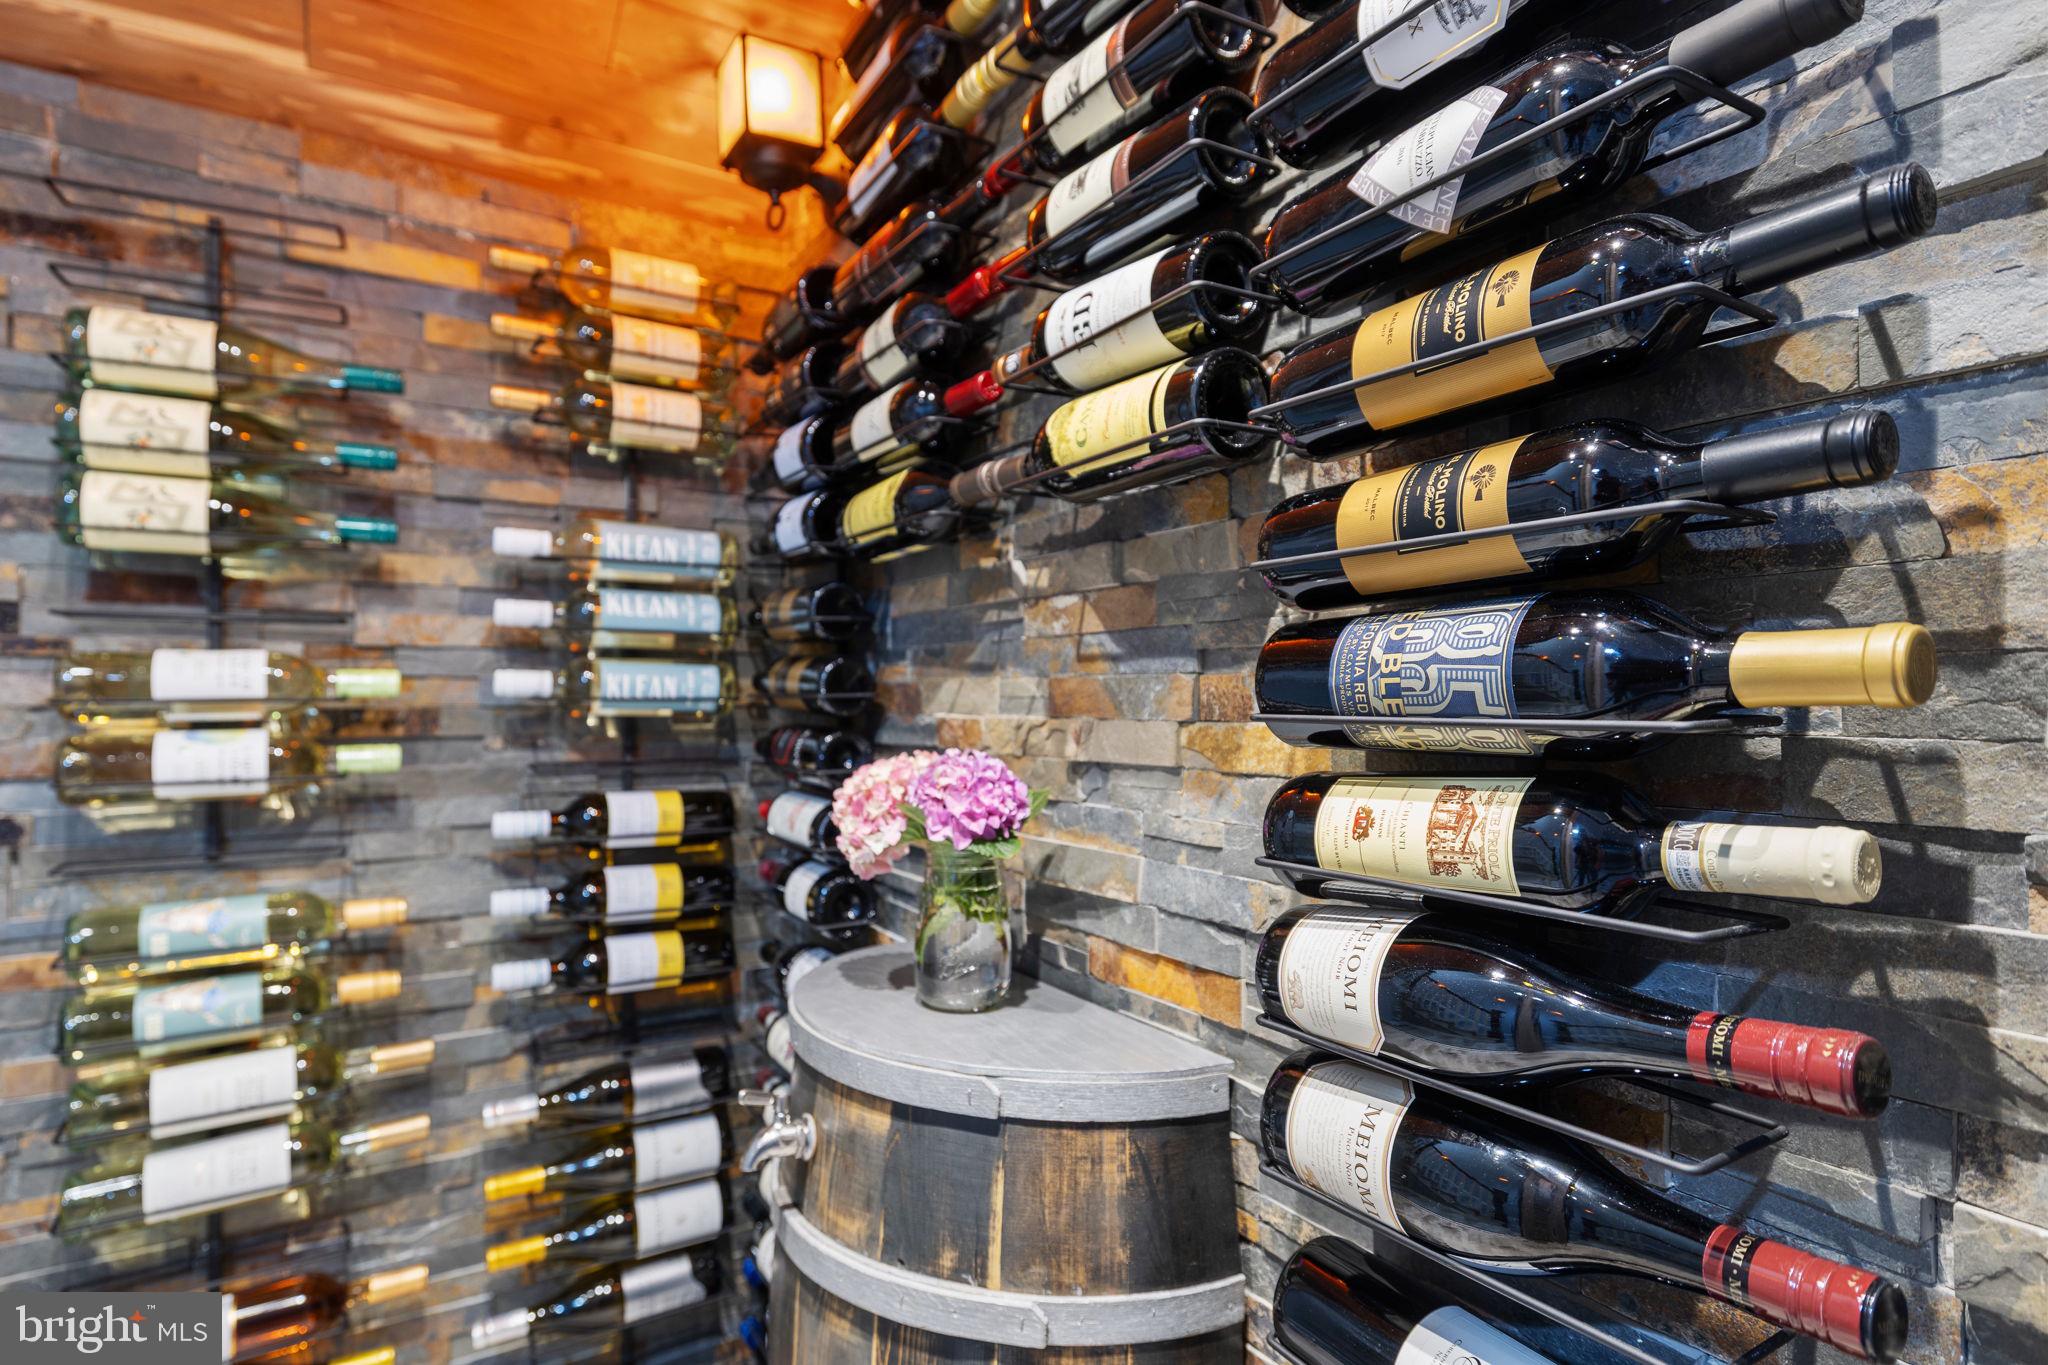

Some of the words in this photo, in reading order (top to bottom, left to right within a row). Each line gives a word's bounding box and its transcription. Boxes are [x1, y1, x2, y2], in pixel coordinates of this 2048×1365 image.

[1386, 311, 1399, 345] MALBEC
[1454, 280, 1474, 342] MOLINO
[1446, 455, 1464, 467] EL
[1369, 487, 1382, 521] MALBEC
[1434, 468, 1454, 529] MOLINO
[606, 532, 678, 562] KLEAN
[1345, 653, 1353, 697] CAYMUS
[1353, 682, 1369, 713] RED
[1399, 801, 1414, 850] CHIANTI
[1491, 785, 1516, 830] CONTE
[1488, 830, 1503, 883] PRIOLA
[1706, 849, 1717, 879] Conte
[1344, 917, 1384, 1012] MEIOMI
[1354, 1103, 1384, 1219] MEIOMI
